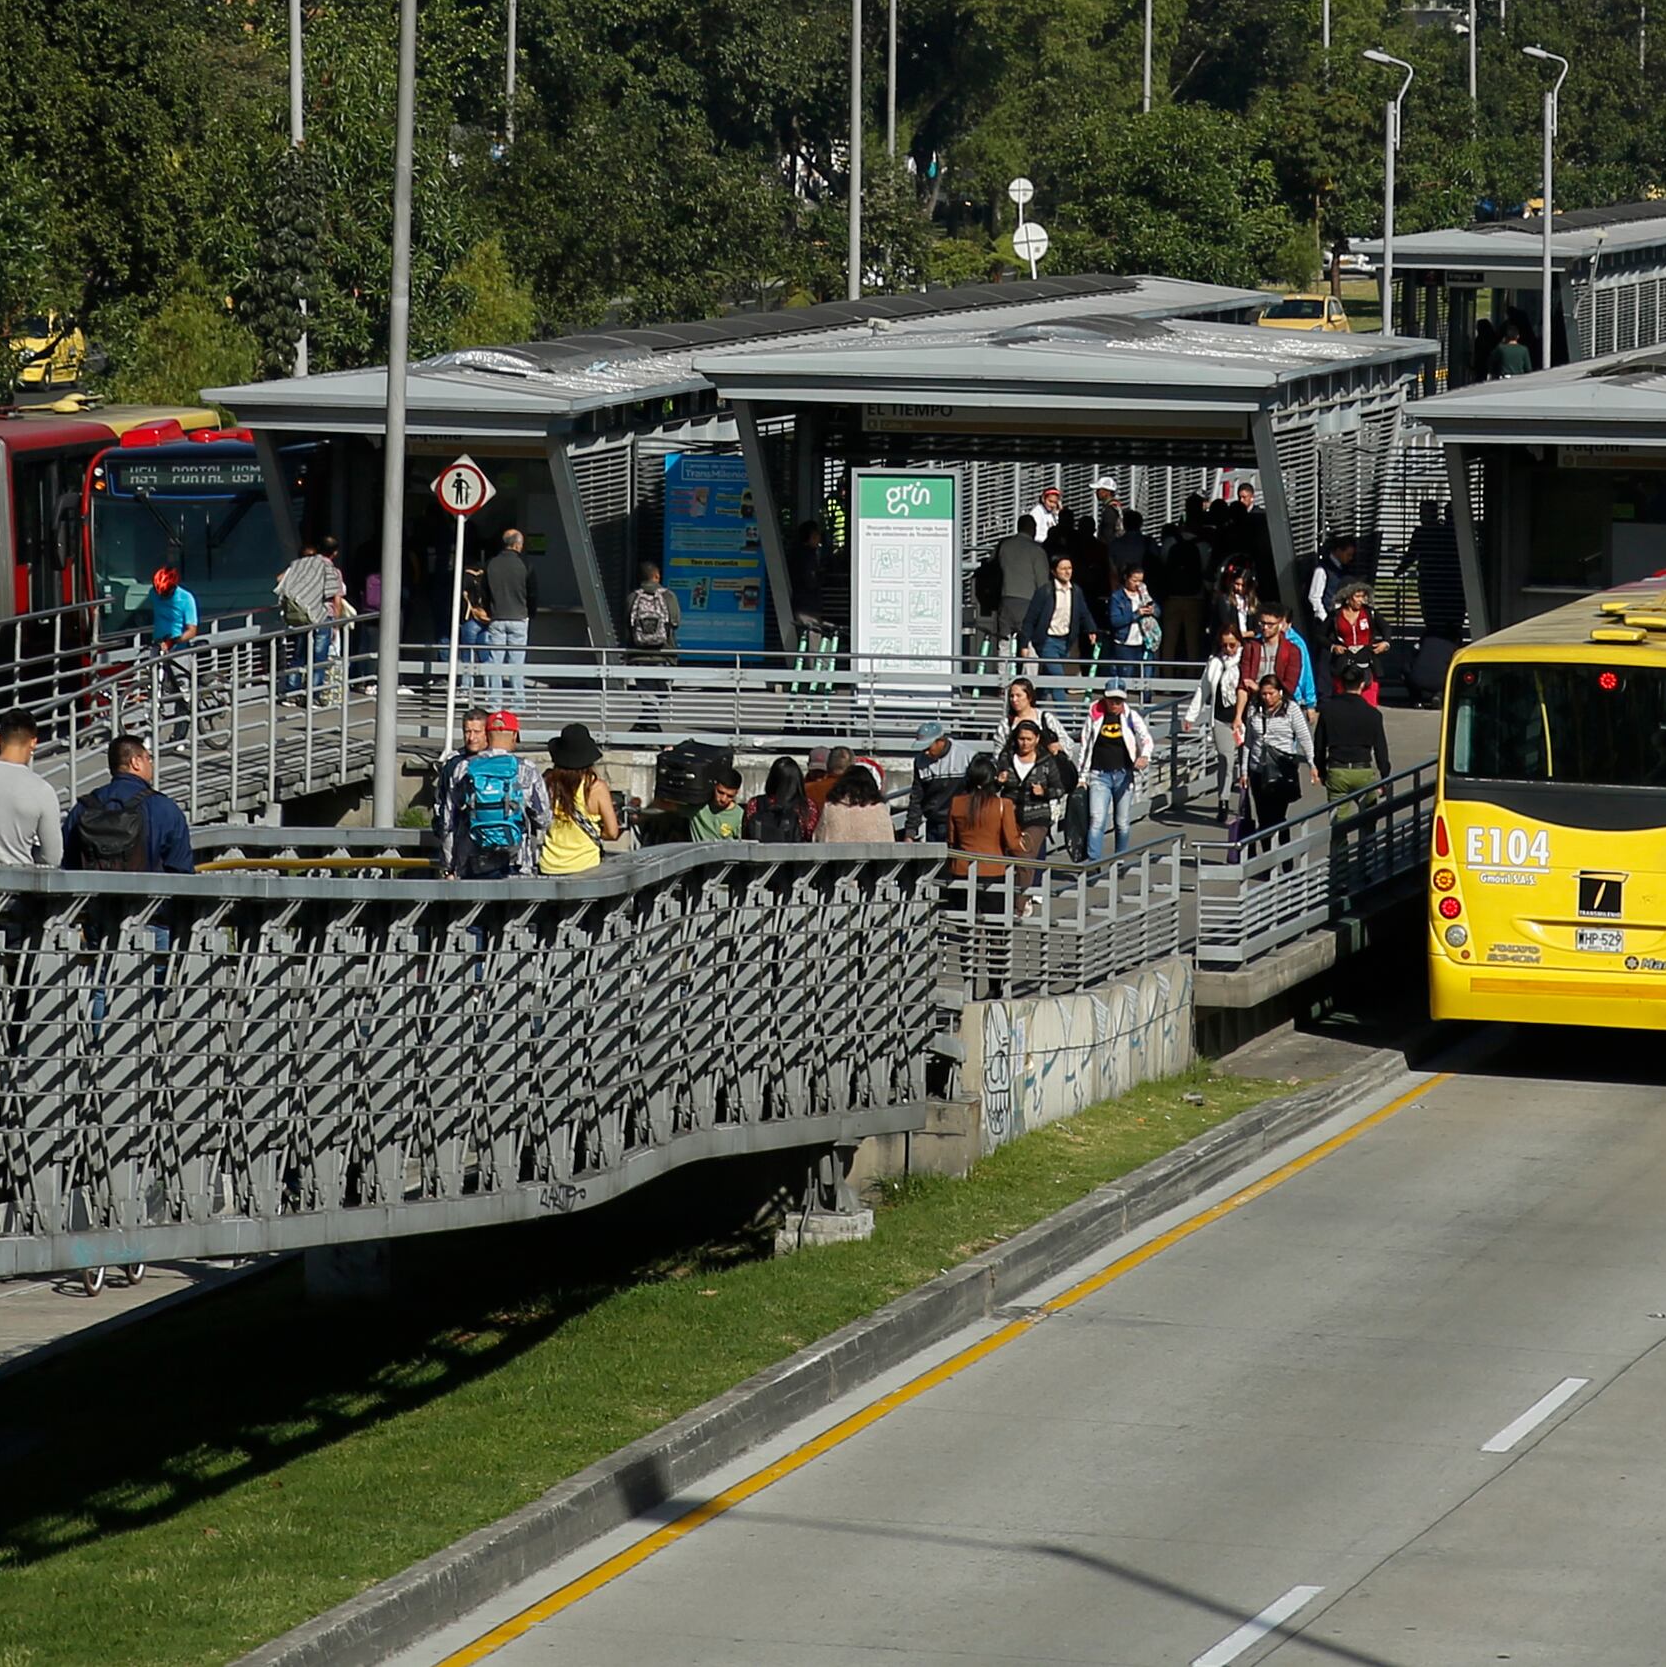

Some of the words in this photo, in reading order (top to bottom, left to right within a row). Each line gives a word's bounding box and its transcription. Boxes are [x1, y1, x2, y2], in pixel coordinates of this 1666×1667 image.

[867, 404, 885, 416] EL
[893, 404, 953, 417] TIEMPO
[886, 481, 930, 516] grin
[1466, 826, 1551, 866] E104
